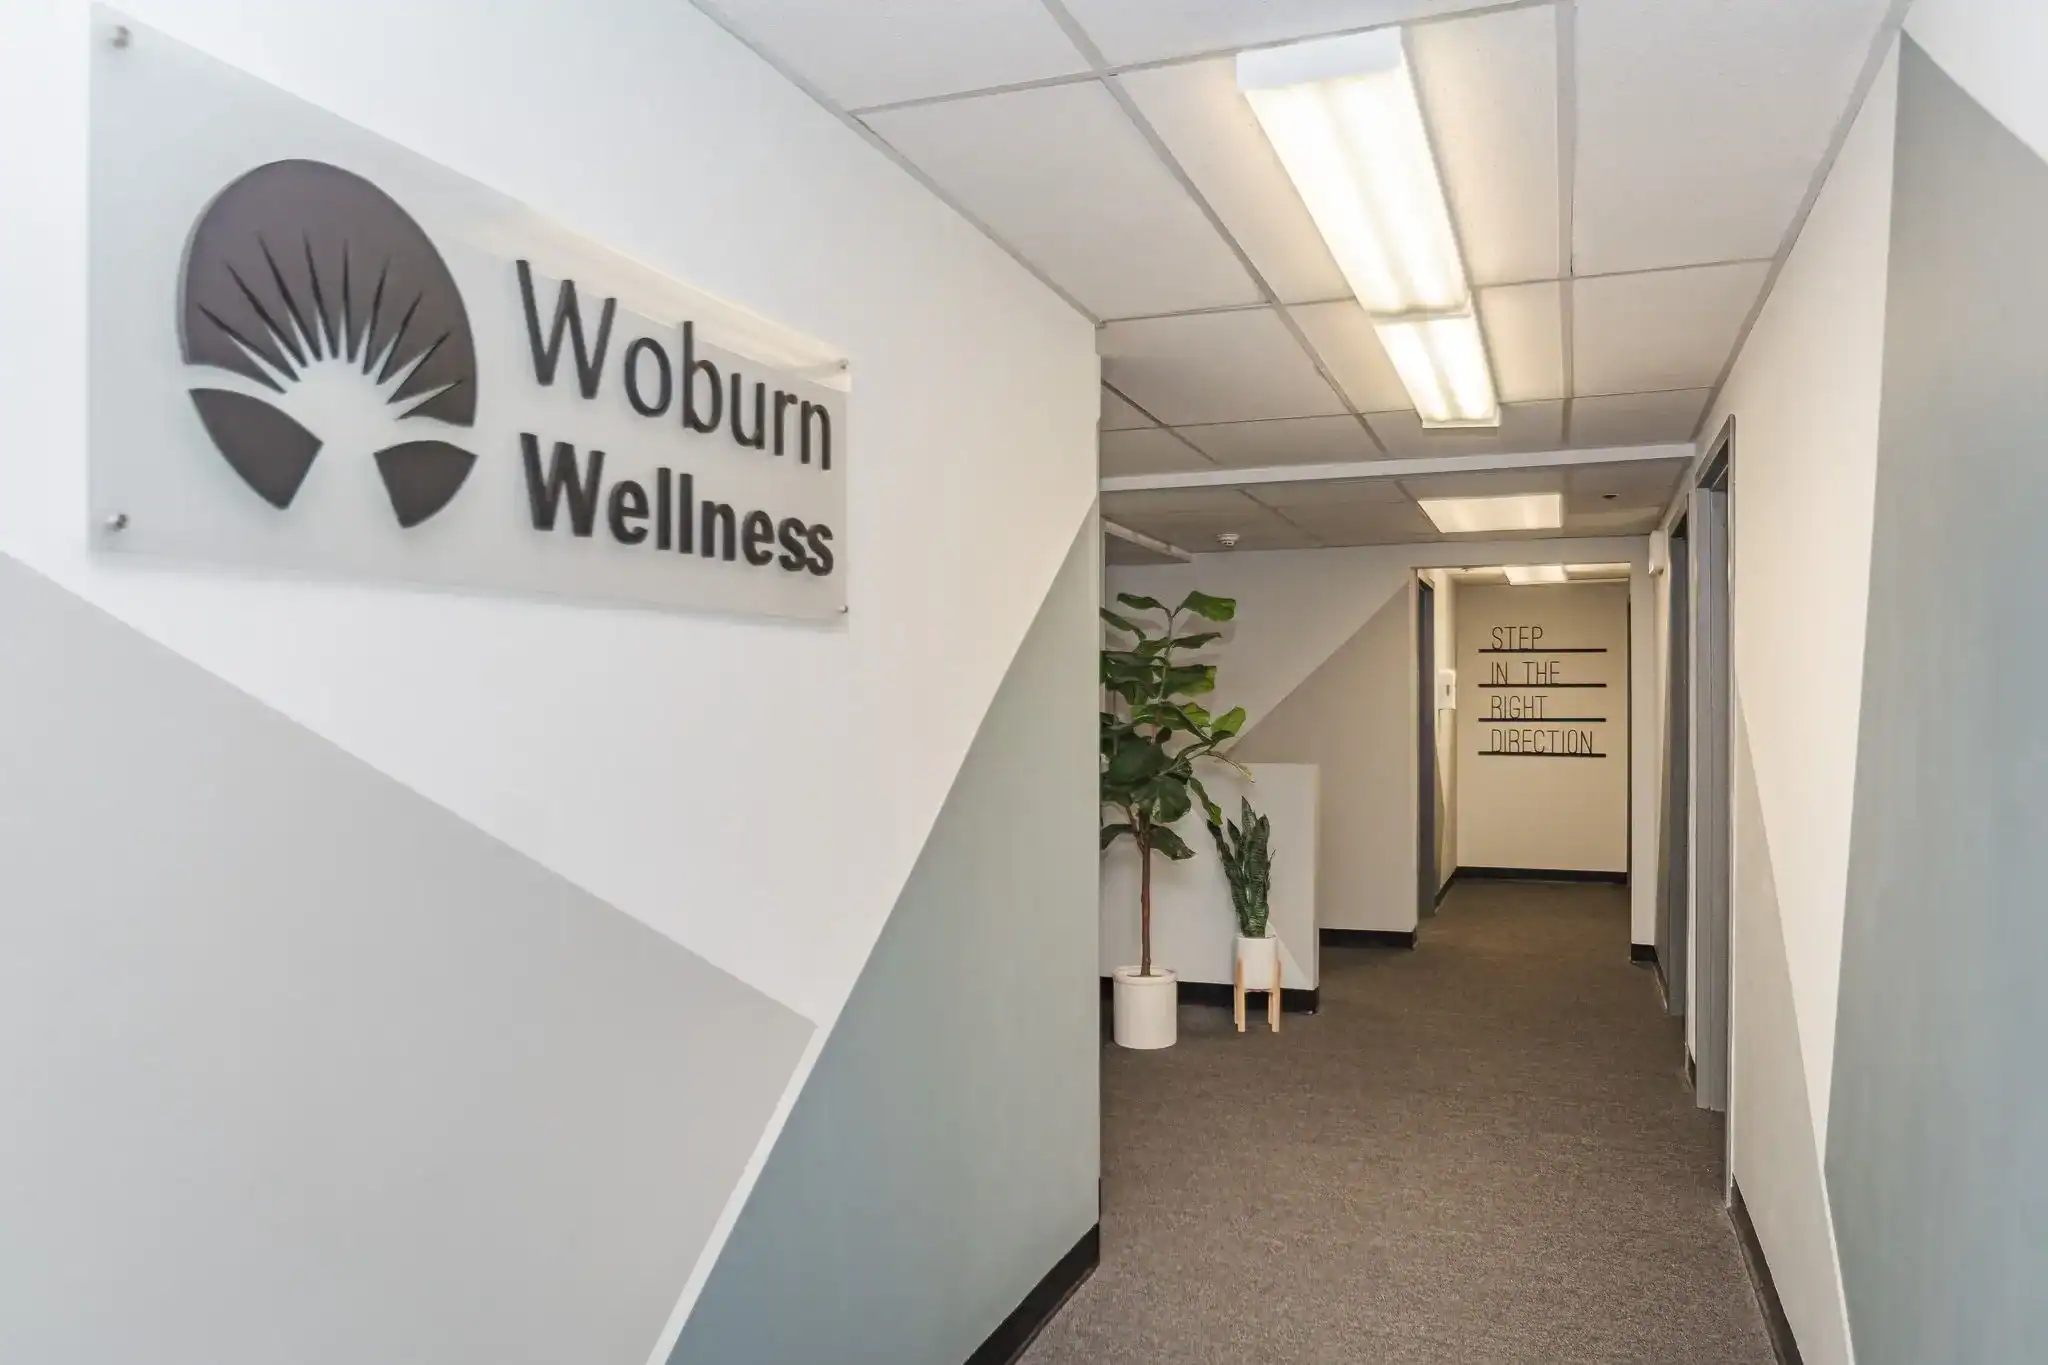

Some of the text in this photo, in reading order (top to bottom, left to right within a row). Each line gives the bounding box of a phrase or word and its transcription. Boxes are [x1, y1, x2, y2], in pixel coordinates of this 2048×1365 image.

[516, 260, 831, 470] Woburn
[520, 432, 833, 576] Wellness
[1491, 626, 1544, 650] STEP
[1491, 661, 1560, 685] IN THE
[1491, 695, 1548, 719] RIGHT
[1491, 729, 1593, 754] DIRECTION
